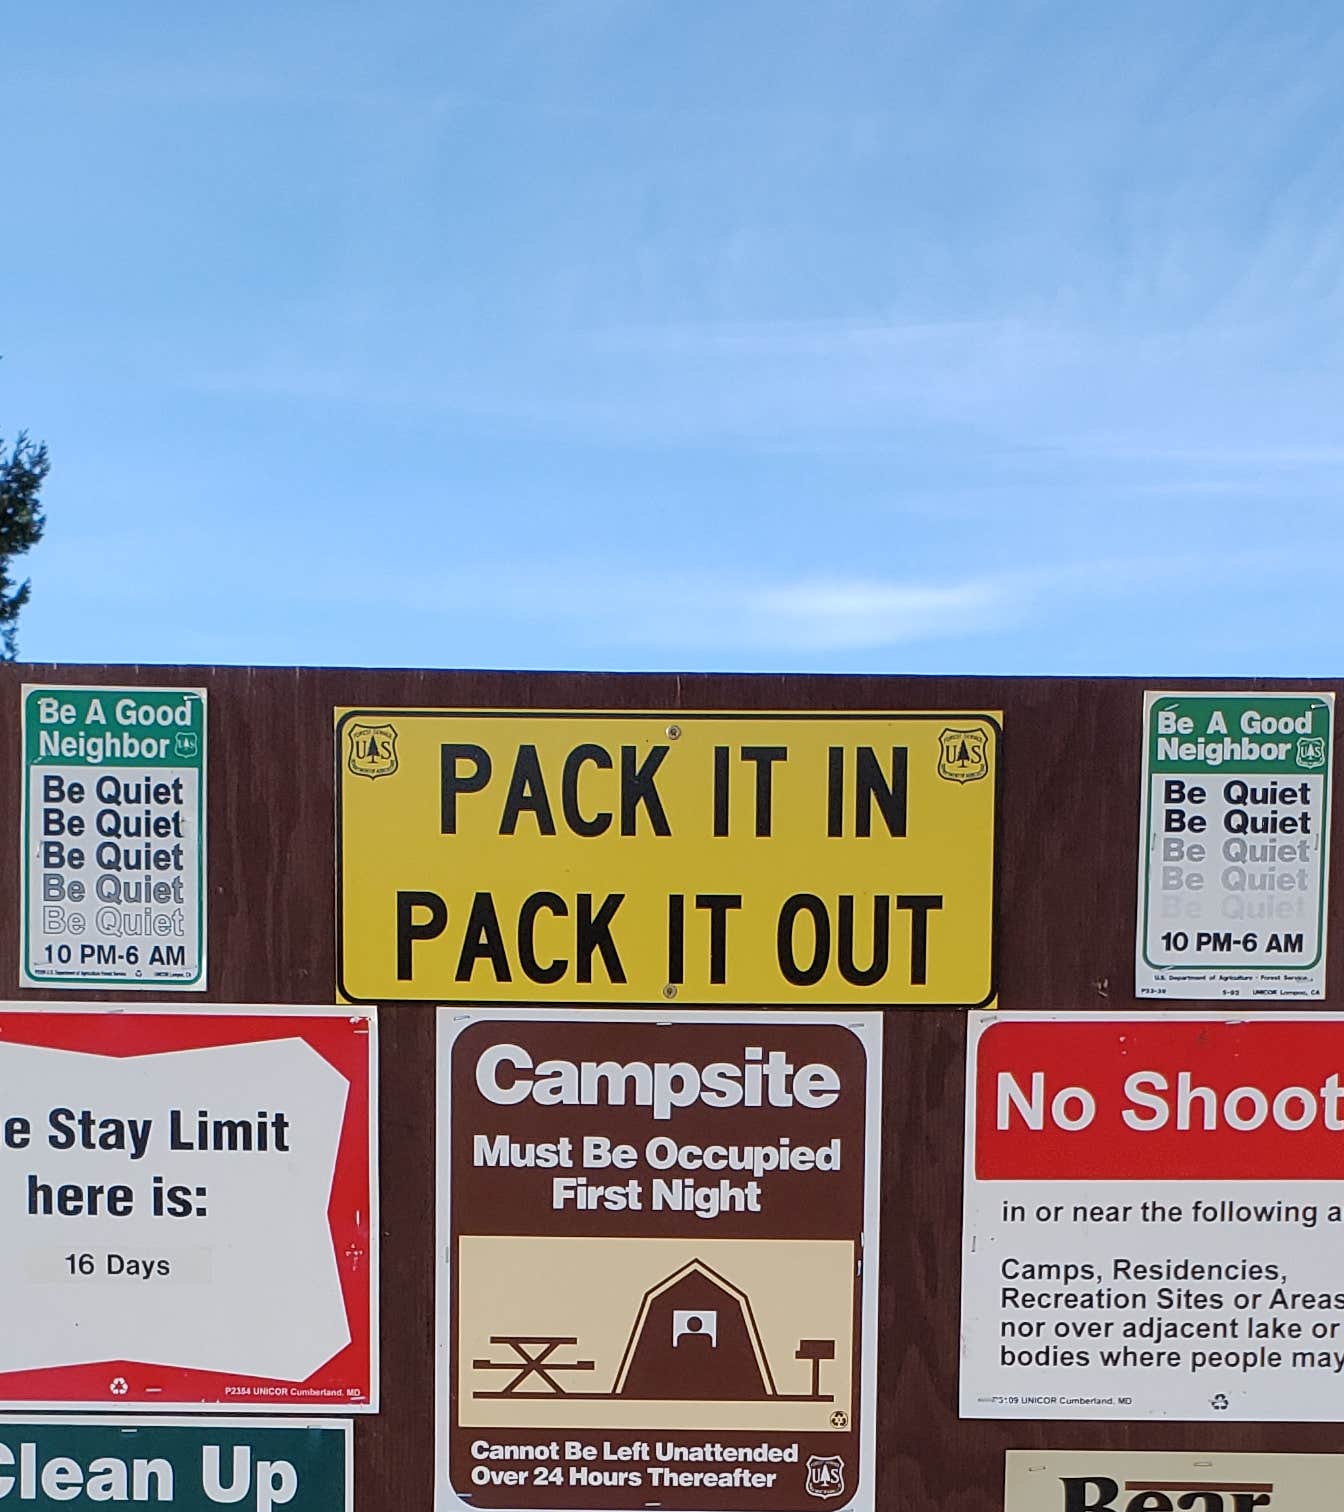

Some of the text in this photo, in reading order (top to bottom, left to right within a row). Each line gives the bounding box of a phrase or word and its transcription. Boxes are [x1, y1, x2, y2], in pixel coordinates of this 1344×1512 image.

[38, 698, 191, 725] Be A Good
[1158, 711, 1312, 734] Be A Good
[38, 731, 169, 763] Neighbor
[1158, 737, 1291, 765] Neighbor
[44, 775, 183, 806] Be Quiet
[441, 744, 908, 837] PACK IT IN
[1164, 780, 1310, 806] Be Quiet
[44, 808, 184, 839] Be Quiet
[1165, 809, 1311, 835] Be Quiet
[41, 841, 183, 872] Be Quiet
[1163, 838, 1310, 864] Be Quiet
[43, 873, 184, 905] Be Quiet
[1162, 866, 1308, 891] Be Quiet
[1160, 890, 1307, 920] Be Quiet
[43, 905, 184, 938] Be Quiet
[397, 891, 943, 986] PACK IT OUT
[1162, 932, 1303, 952] 10 PM-6 AM
[45, 944, 184, 965] 10 PM-6 AM
[476, 1044, 840, 1119] Campsite
[997, 1072, 1095, 1131] No
[49, 1108, 152, 1159] Stay
[171, 1110, 289, 1151] Limit
[474, 1135, 840, 1177] Must Be Occupied
[28, 1175, 206, 1217] here is:
[553, 1177, 761, 1218] First Night
[1004, 1201, 1024, 1221] in
[1036, 1206, 1063, 1221] or
[1074, 1206, 1132, 1222] near
[1141, 1201, 1182, 1222] the
[1192, 1201, 1316, 1227] following
[66, 1254, 169, 1279] 16 Days
[1002, 1259, 1286, 1285] Camps, Residencies,
[1002, 1288, 1145, 1308] Recreation
[1157, 1288, 1223, 1309] Sites
[1234, 1294, 1262, 1309] or
[1002, 1322, 1045, 1337] nor
[1055, 1322, 1114, 1337] over
[1123, 1317, 1238, 1343] adjacent
[1248, 1318, 1301, 1338] lake
[1312, 1323, 1340, 1338] or
[1001, 1345, 1089, 1366] bodies
[1100, 1346, 1180, 1367] where
[1192, 1347, 1281, 1372] people
[252, 1387, 289, 1396] UNICOR
[346, 1388, 361, 1397] MD
[471, 1440, 798, 1462] Cannot Be Left Unattended
[472, 1466, 776, 1487] Over 24 Hours Thereafter
